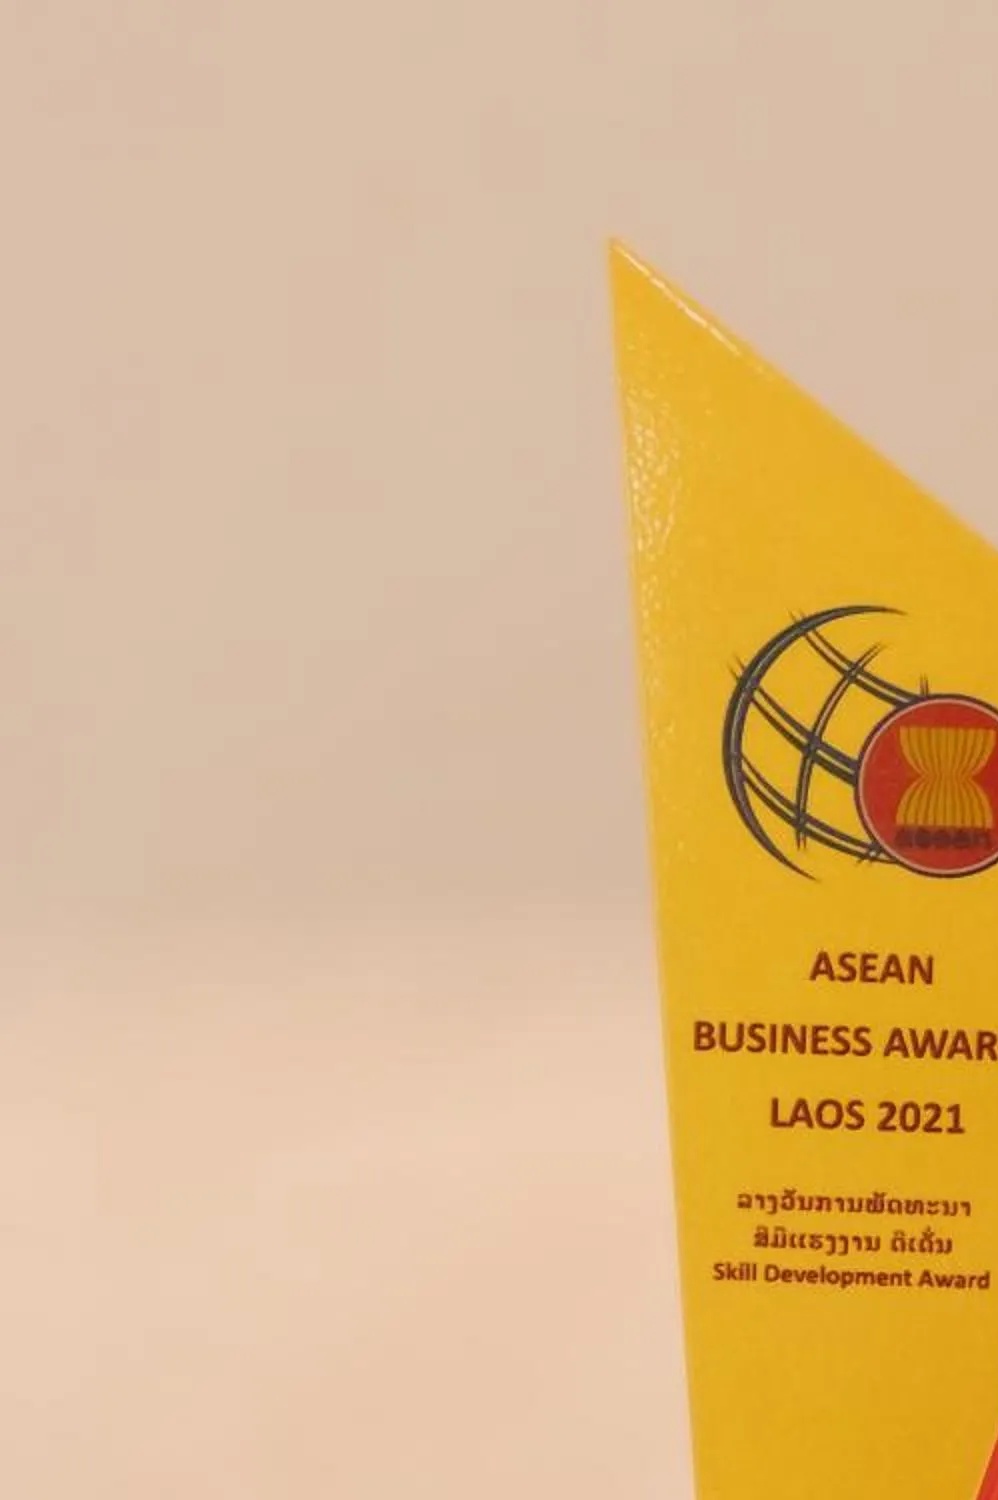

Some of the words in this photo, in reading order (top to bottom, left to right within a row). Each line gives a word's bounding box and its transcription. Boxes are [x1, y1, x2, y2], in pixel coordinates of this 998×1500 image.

[809, 951, 934, 985] ASEAN
[694, 1020, 873, 1057] BUSINESS
[770, 1097, 865, 1131] LAOS
[877, 1101, 965, 1134] 2021
[712, 1262, 757, 1282] Skill
[764, 1265, 912, 1289] Development
[917, 1269, 990, 1290] Award
